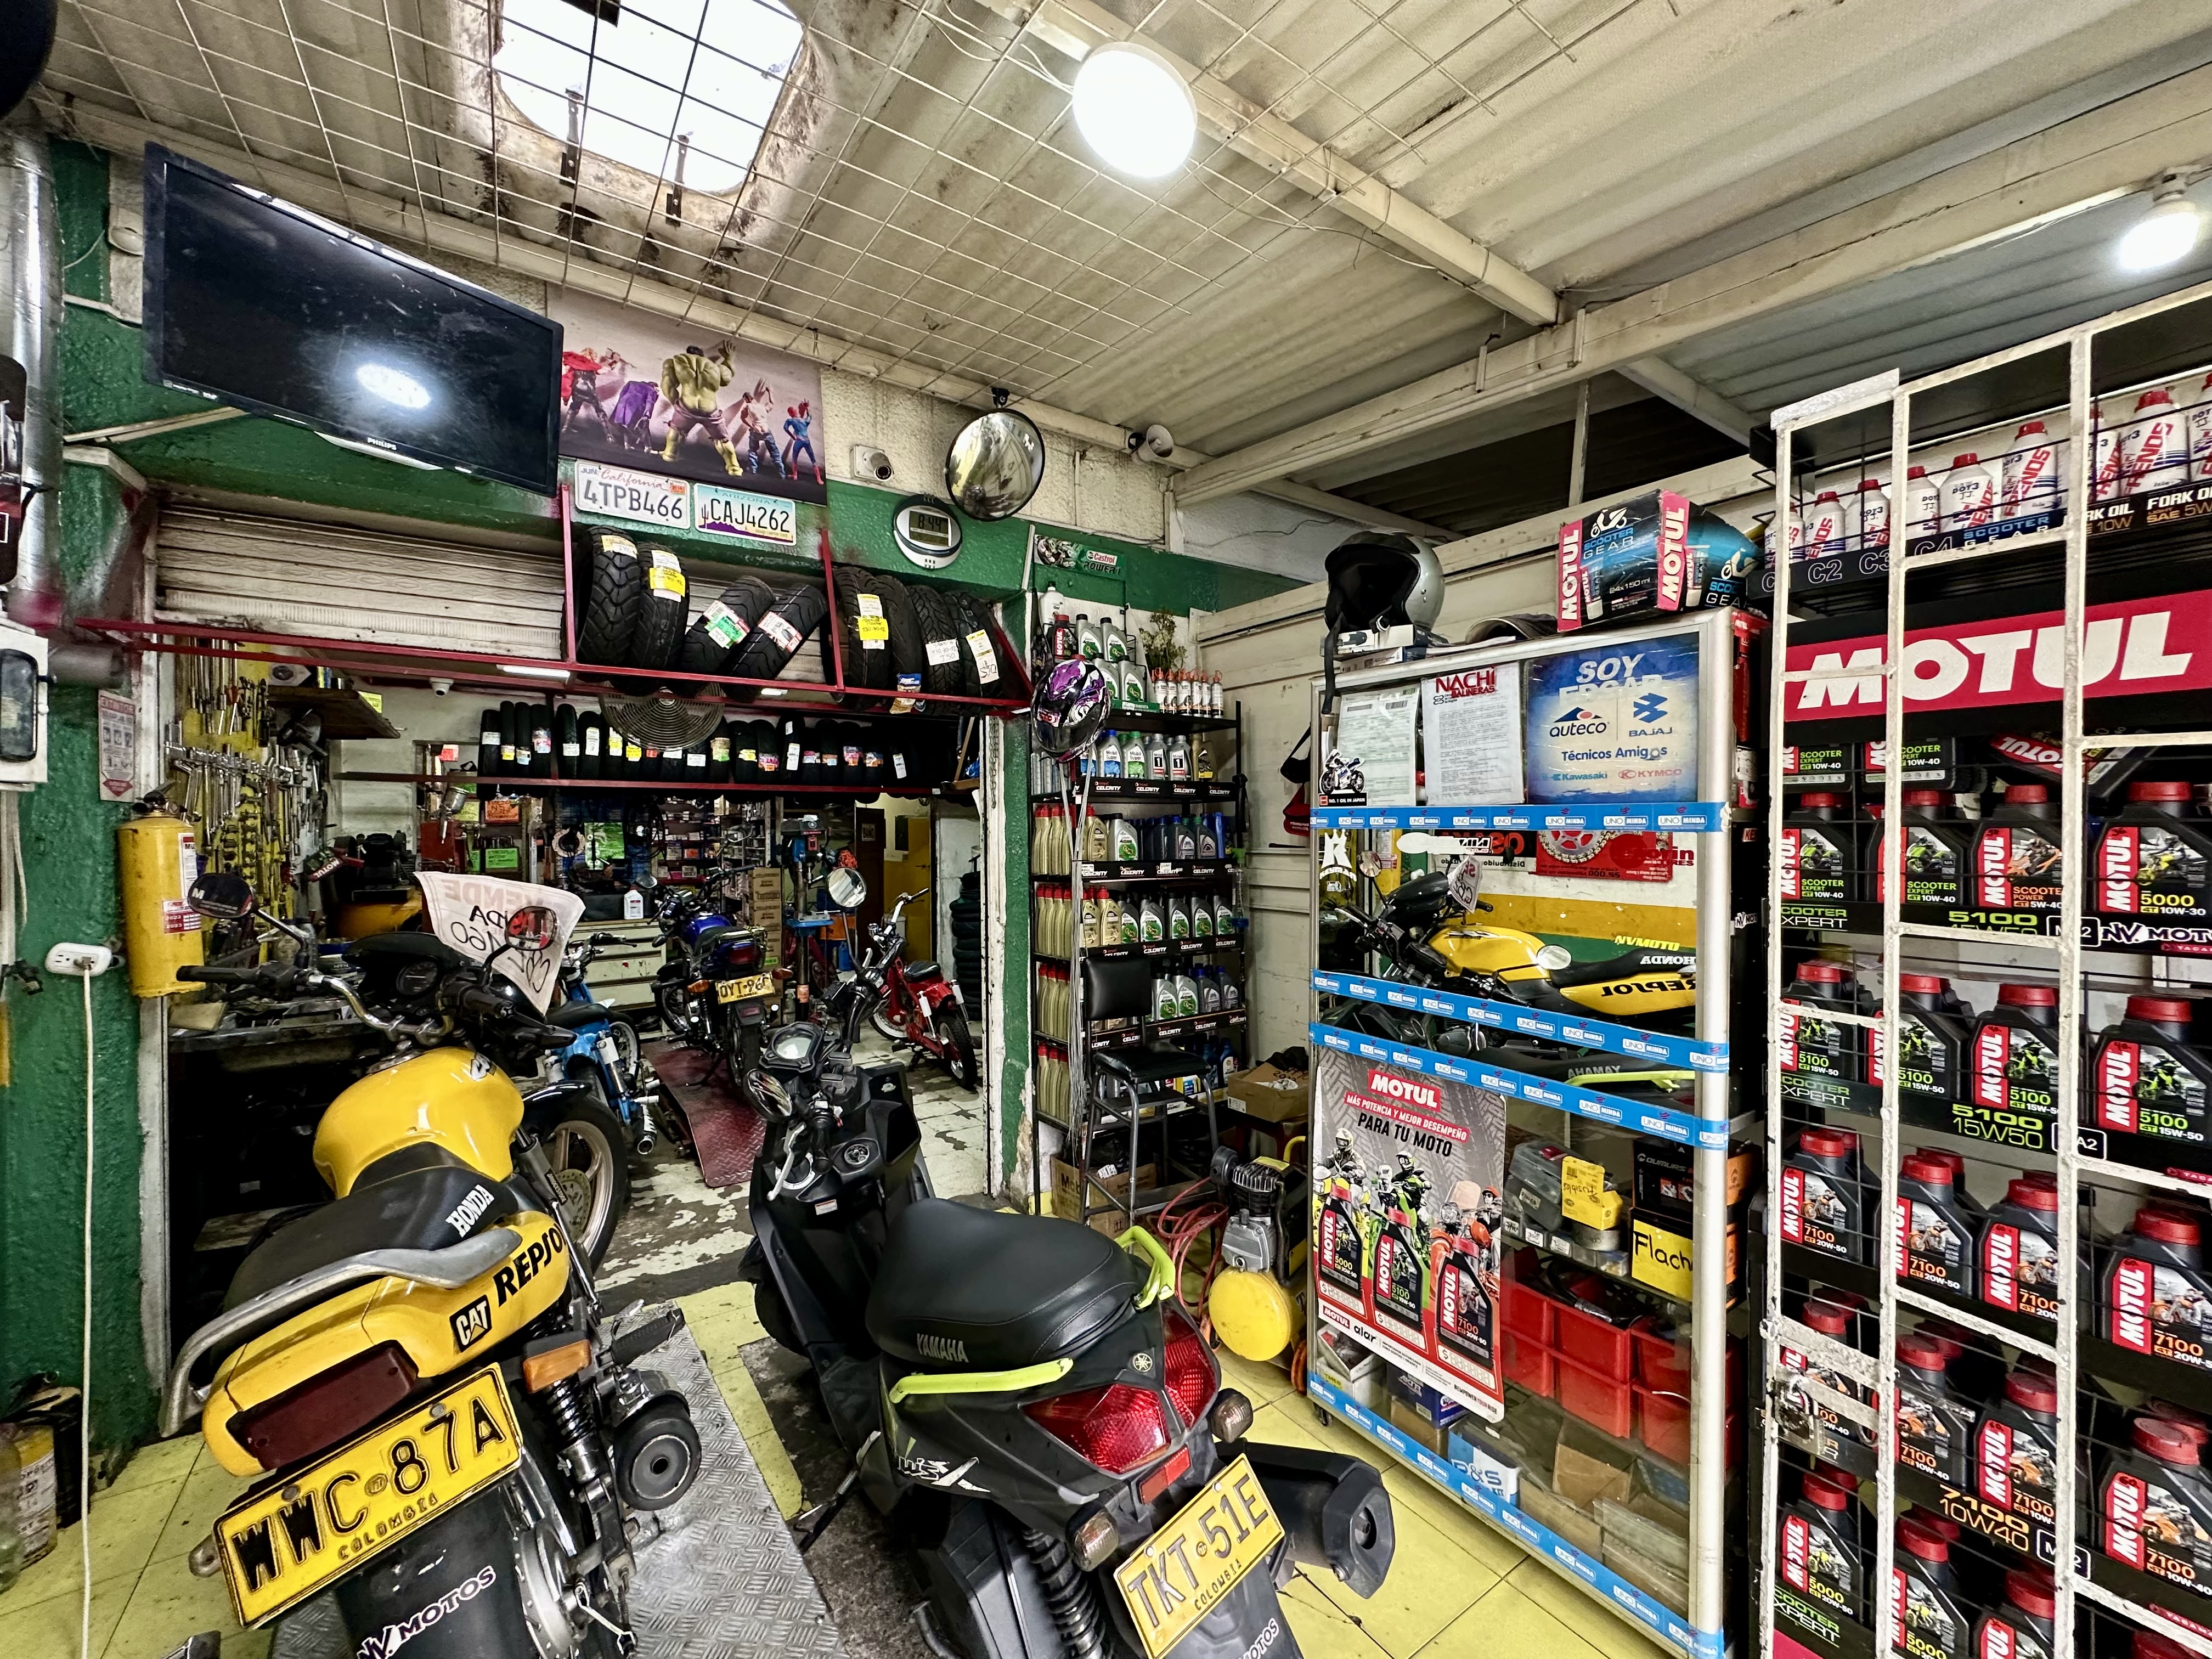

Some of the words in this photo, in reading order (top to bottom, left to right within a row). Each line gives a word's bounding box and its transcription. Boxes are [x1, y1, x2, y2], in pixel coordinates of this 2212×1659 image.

[368, 437, 396, 450] PHILIPS
[600, 469, 669, 491] California
[584, 479, 683, 520] 4TPB466
[721, 492, 771, 505] ARIZONA
[2108, 503, 2135, 517] OIL
[2147, 492, 2193, 510] FORK
[710, 499, 790, 533] CAJ4262
[917, 515, 942, 532] 8:44
[2147, 510, 2180, 523] SAE
[1583, 527, 1634, 551] SCOOTER
[1963, 516, 2050, 540] SCOOTER
[1093, 552, 1115, 564] Castrol
[1583, 535, 1634, 560] GEAR
[1662, 506, 1685, 602] MOTUL
[1561, 528, 1579, 620] MOTUL
[1808, 559, 1843, 584] C2
[1053, 629, 1064, 656] MOTUL
[1576, 653, 1645, 683] SOY
[1797, 611, 2193, 709] MOTUL
[1452, 685, 1498, 699] BALINERAS
[1549, 722, 1606, 737] auteco
[1629, 727, 1673, 737] BAJAJ
[1561, 748, 1611, 761] Técnicos
[1615, 745, 1667, 760] Amigos
[1799, 749, 1842, 758] SCOOTER
[1906, 758, 1940, 766] 10W-40
[1562, 771, 1607, 781] Kawasaki
[1638, 769, 1682, 777] KYMCO
[1781, 835, 1796, 896] MOTUL
[1984, 836, 2006, 906] MOTUL
[2106, 836, 2132, 911] MOTUL
[1802, 879, 1844, 887] SCOOTER
[1907, 881, 1956, 891] SCOOTER
[1921, 895, 1956, 904] 10W-40
[2140, 894, 2194, 907] 5000
[2161, 906, 2207, 916] 10W-30
[1782, 916, 1848, 928] XPERT
[1948, 911, 2038, 925] 5100
[1615, 935, 1680, 951] NVMOTO
[1564, 1028, 1582, 1038] UNO
[1624, 1040, 1643, 1050] UNO
[1646, 1045, 1668, 1054] MINDA
[1799, 1053, 1829, 1067] 5100
[1810, 1065, 1839, 1076] 15W-50
[1981, 1034, 2003, 1104] MOTUL
[1899, 1071, 1933, 1085] 5100
[1911, 1082, 1945, 1094] 15W-50
[2106, 1049, 2131, 1127] MOTUL
[1371, 1074, 1438, 1108] MOTUL
[2010, 1090, 2051, 1105] 5100
[1347, 1094, 1361, 1107] MÁS
[1361, 1099, 1392, 1116] POTENCIA
[1399, 1111, 1422, 1126] MEJOR
[1423, 1118, 1467, 1141] DESEMPEÑO
[1581, 1102, 1599, 1111] UNO
[1952, 1104, 2042, 1130] 5100
[1643, 1118, 1662, 1128] UNO
[1665, 1123, 1687, 1136] MINDA
[1953, 1116, 2042, 1149] 15W50
[2141, 1111, 2188, 1131] 5100
[1357, 1112, 1390, 1137] PARA
[1394, 1124, 1410, 1142] TU
[1413, 1131, 1453, 1158] MOTO
[2159, 1126, 2204, 1142] 15W-50
[445, 1184, 495, 1238] HONDA
[1784, 1175, 1800, 1238] MOTUL
[1323, 1215, 1334, 1265] MOTUL
[1804, 1225, 1835, 1243] 7100
[1816, 1239, 1848, 1254] 20W-50
[1335, 1255, 1353, 1271] 5000
[1379, 1241, 1391, 1294] MOTUL
[1910, 1258, 1946, 1277] 7100
[1990, 1233, 2012, 1306] MOTUL
[1392, 1285, 1410, 1300] 5100
[1924, 1272, 1961, 1290] 20W-50
[1443, 1270, 1456, 1328] MOTUL
[2120, 1268, 2145, 1347] MOTUL
[455, 1300, 489, 1347] CAT
[1324, 1306, 1350, 1329] MOTUL
[1353, 1324, 1376, 1344] alar
[1458, 1317, 1479, 1335] 7100
[916, 1333, 969, 1363] YAMAHA
[2154, 1333, 2204, 1357] 7100
[1901, 1444, 1937, 1468] 7100
[1985, 1429, 2006, 1503] MOTUL
[1916, 1461, 1950, 1481] 10W-40
[1940, 1483, 2029, 1533] 7100
[2013, 1491, 2055, 1518] 7100
[337, 1493, 439, 1560] COLOMBIA
[1939, 1499, 2029, 1551] 10W40
[2113, 1481, 2138, 1563] MOTUL
[1787, 1522, 1804, 1588] MOTUL
[2146, 1549, 2196, 1580] 7100
[1193, 1559, 1243, 1610] COLOMBIA
[1809, 1579, 1844, 1604] 5000
[398, 1565, 496, 1641] MOTOS
[1821, 1595, 1853, 1616] 20W-50
